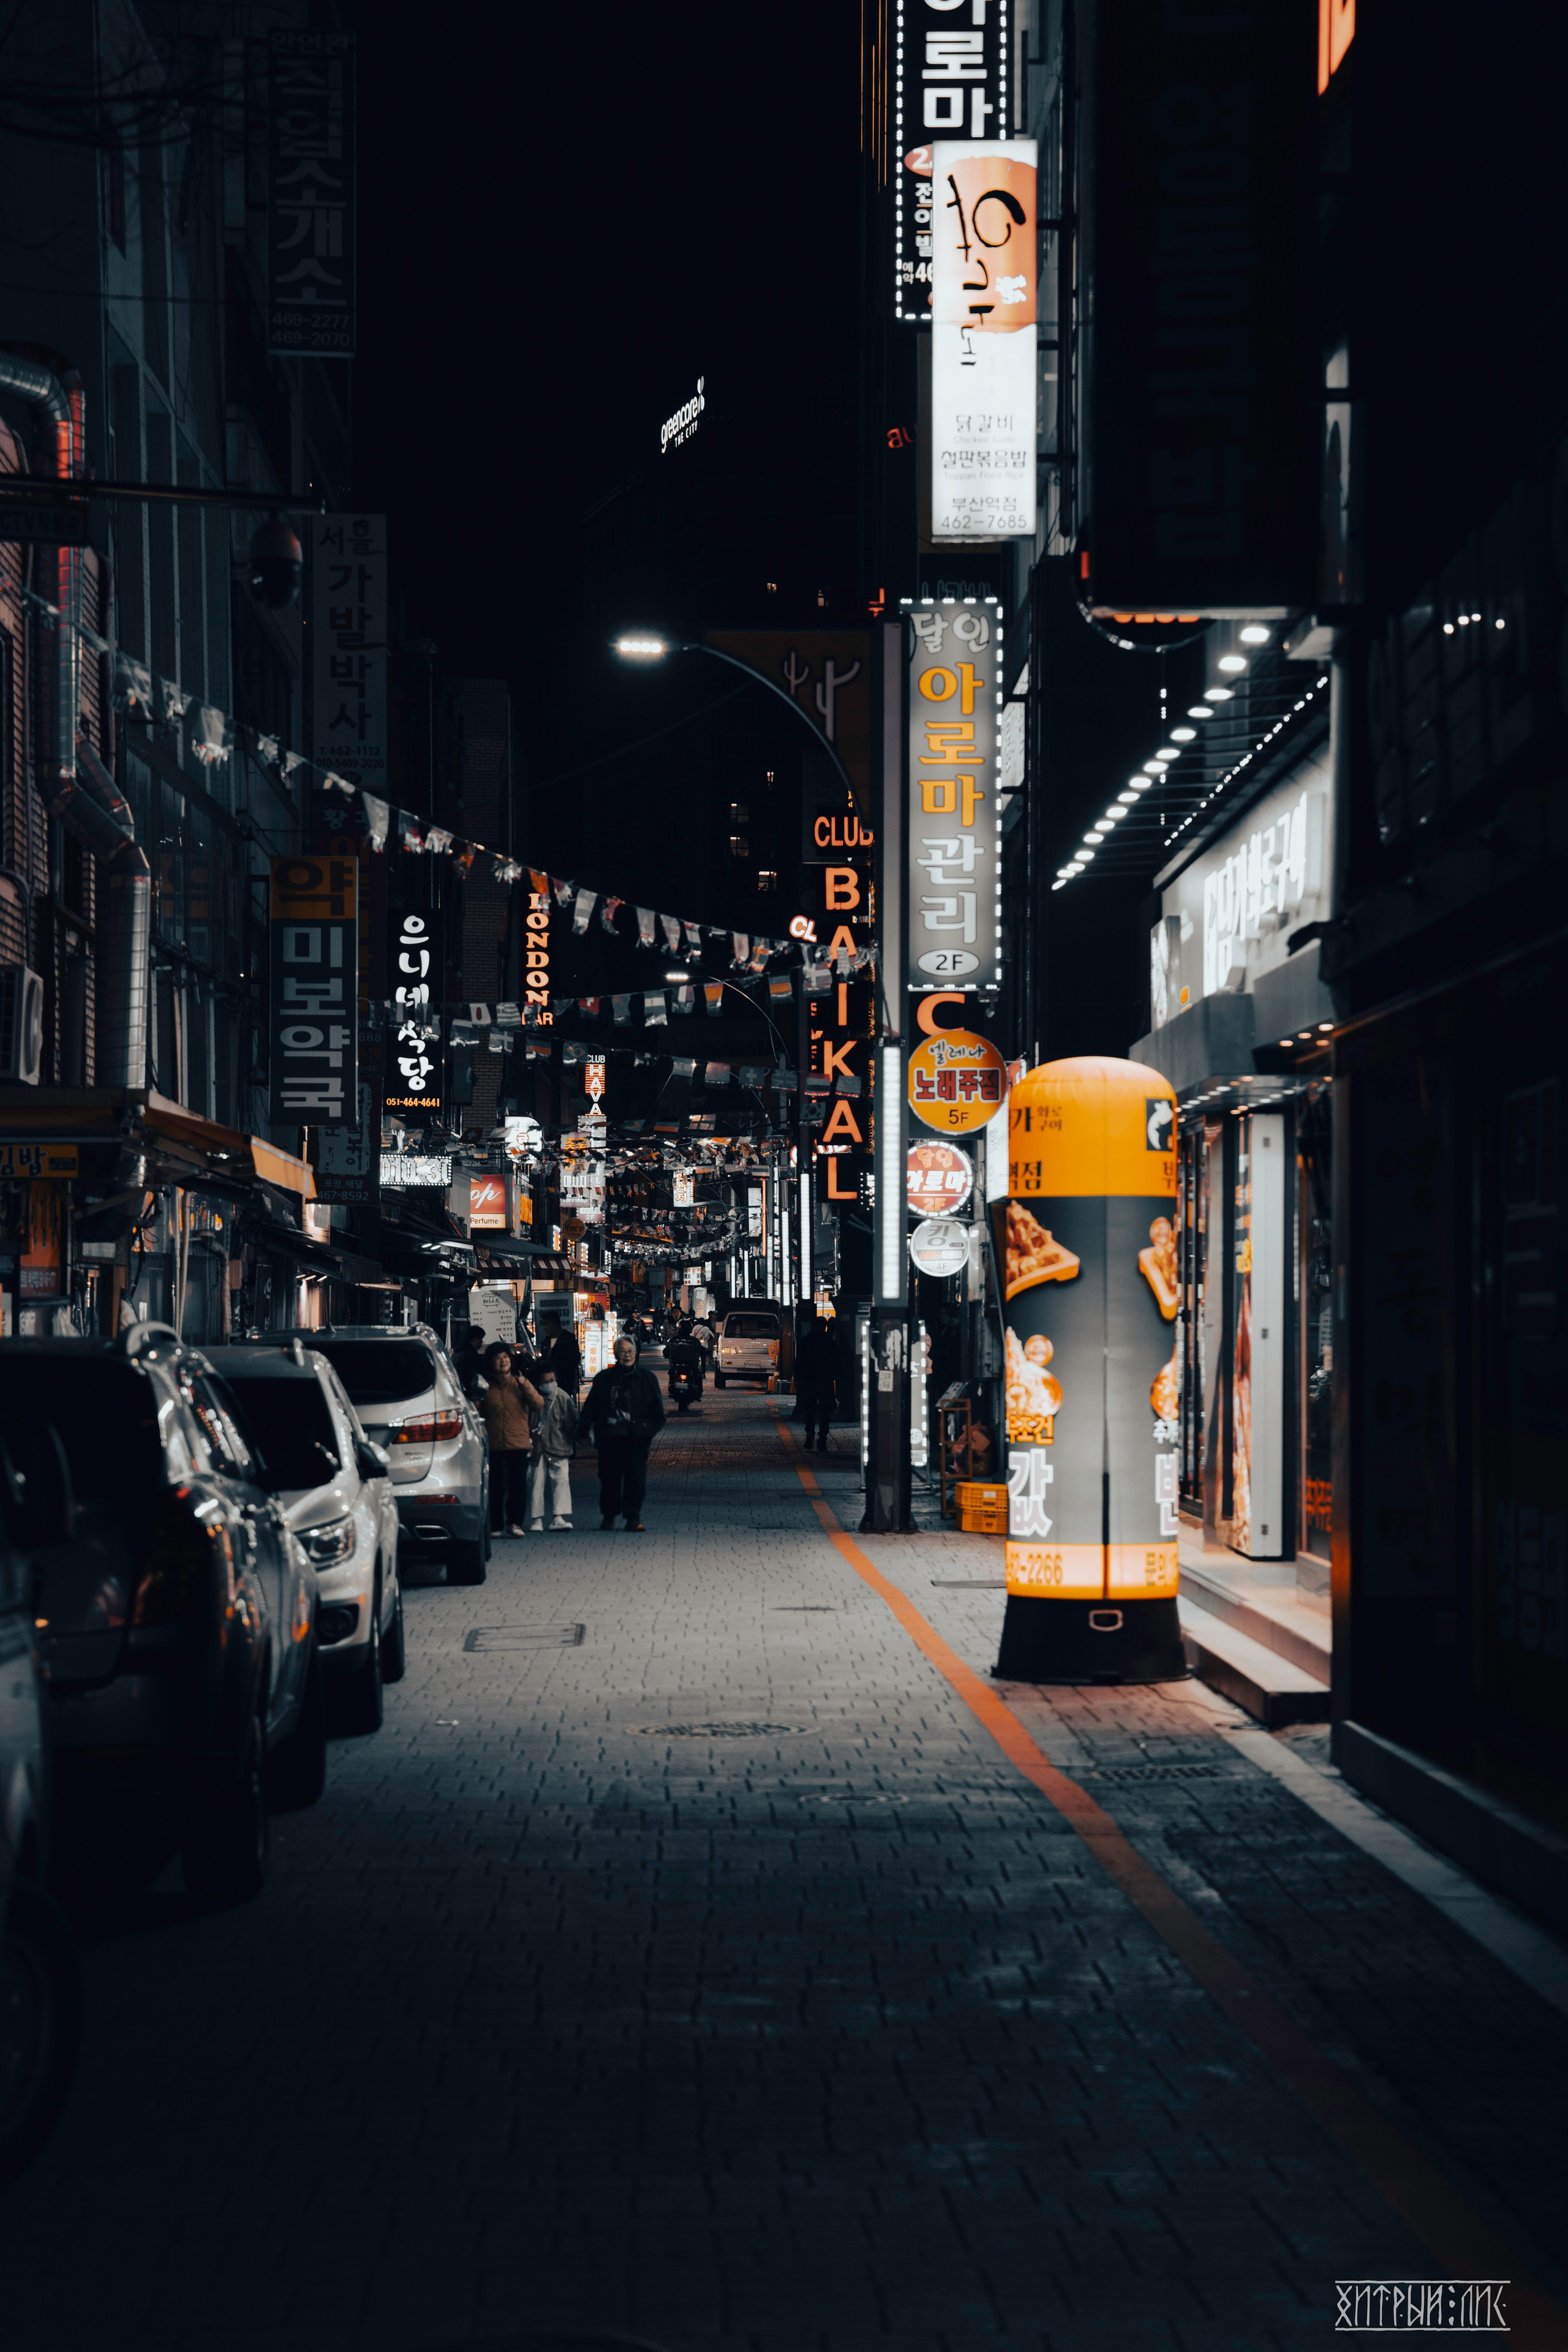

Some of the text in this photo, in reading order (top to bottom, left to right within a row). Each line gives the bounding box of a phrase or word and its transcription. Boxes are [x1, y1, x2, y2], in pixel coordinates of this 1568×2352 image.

[272, 312, 349, 329] 469-2277
[271, 331, 350, 347] 469-2070
[662, 396, 698, 453] greencore
[956, 415, 1012, 432] 닭갈비
[675, 420, 698, 448] THE CITY
[952, 497, 1016, 512] 부산역점
[941, 515, 1027, 529] 462-7685
[320, 519, 385, 556] 서울
[328, 564, 386, 741] 가발 박사
[919, 663, 985, 826] 아로마
[316, 758, 384, 768] 010-5409-2020
[814, 816, 874, 846] CLUB
[275, 861, 353, 916] 약
[916, 834, 985, 943] 관리
[936, 955, 963, 970] 2F
[280, 927, 350, 1118] 미보약국
[522, 1012, 553, 1025] AR
[823, 867, 864, 1199] BAIKAL
[587, 1055, 605, 1063] CLUB
[930, 1041, 986, 1065] 엘레나
[916, 1070, 1000, 1101] 노래주점
[386, 1098, 440, 1107] 051-464-4641
[949, 1109, 969, 1125] 5F
[564, 1175, 586, 1188] 마사지
[907, 1170, 966, 1192] 아로마
[317, 1191, 369, 1200] 467-8592
[924, 1198, 946, 1211] 2F
[927, 1225, 949, 1246] 킹
